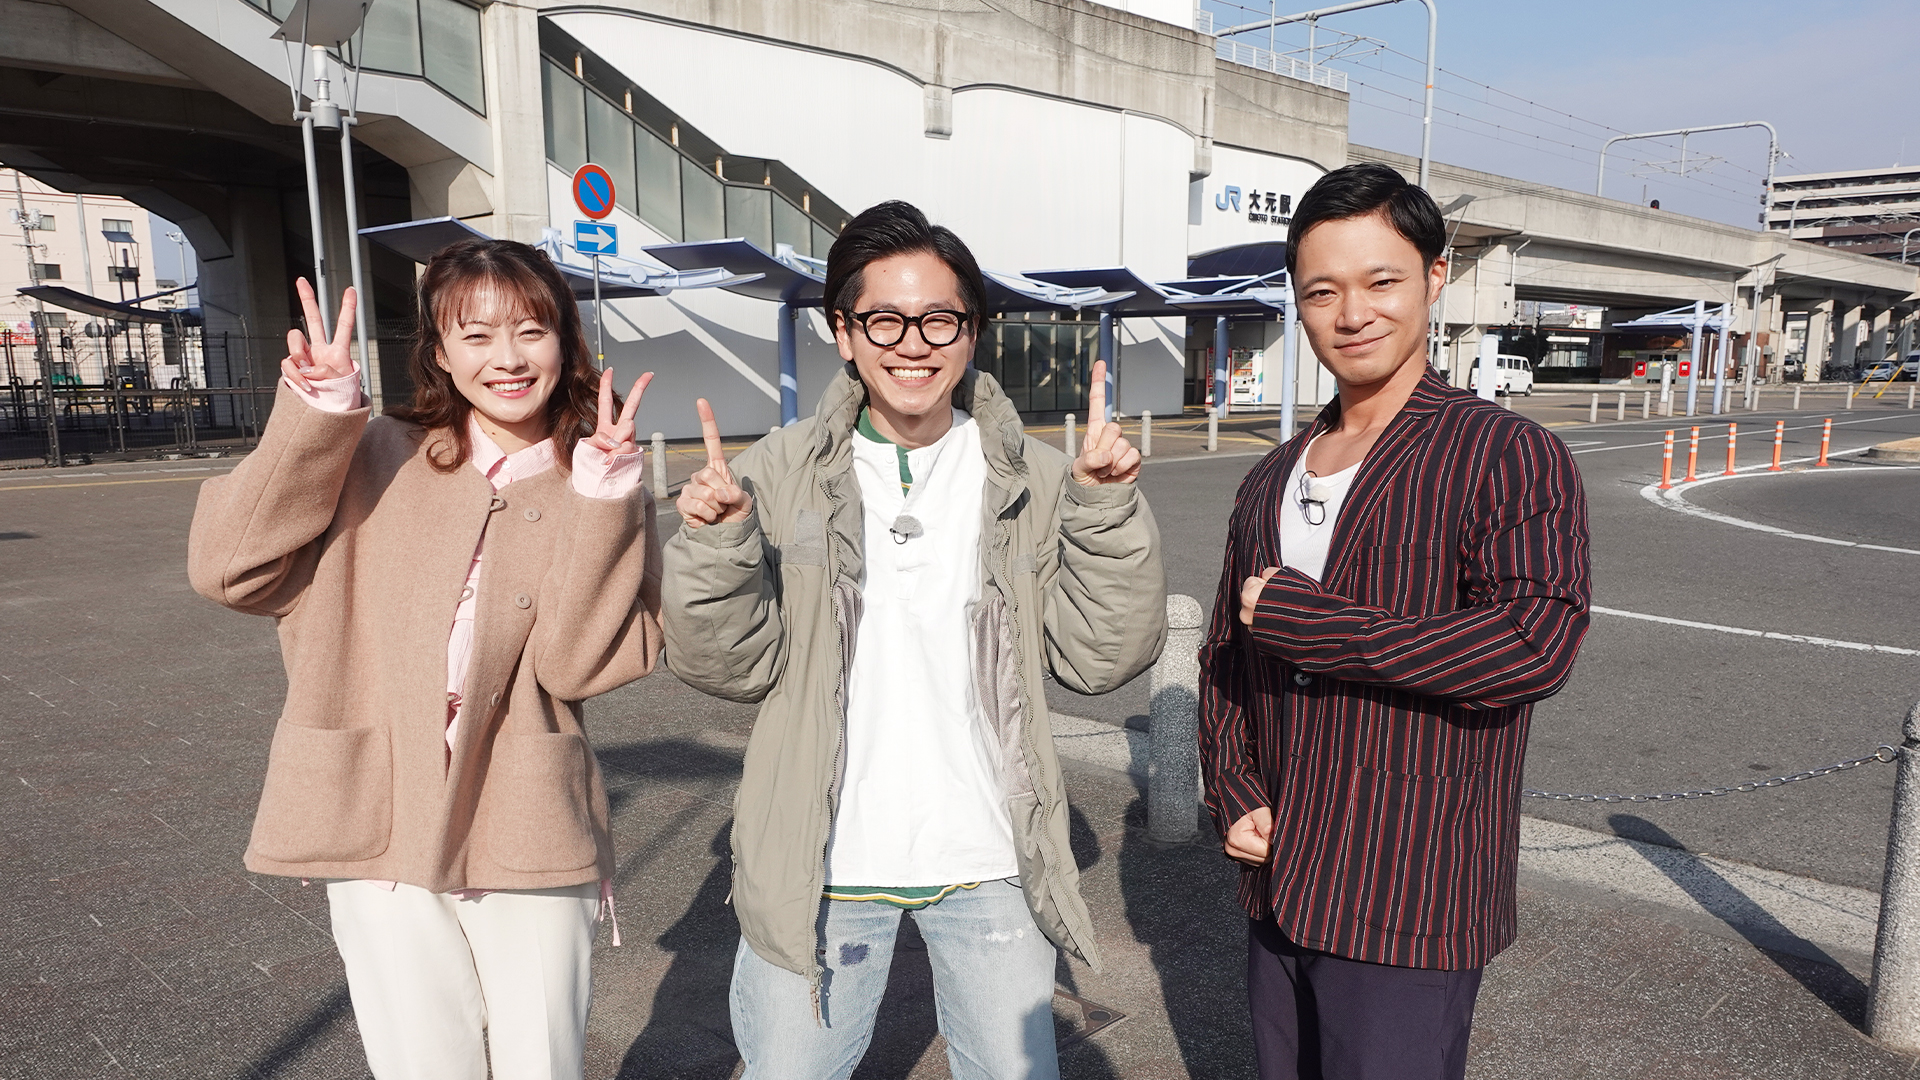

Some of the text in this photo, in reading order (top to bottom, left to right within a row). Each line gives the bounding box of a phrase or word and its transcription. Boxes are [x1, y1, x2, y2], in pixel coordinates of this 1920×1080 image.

[1216, 185, 1291, 214] JR 大元駅
